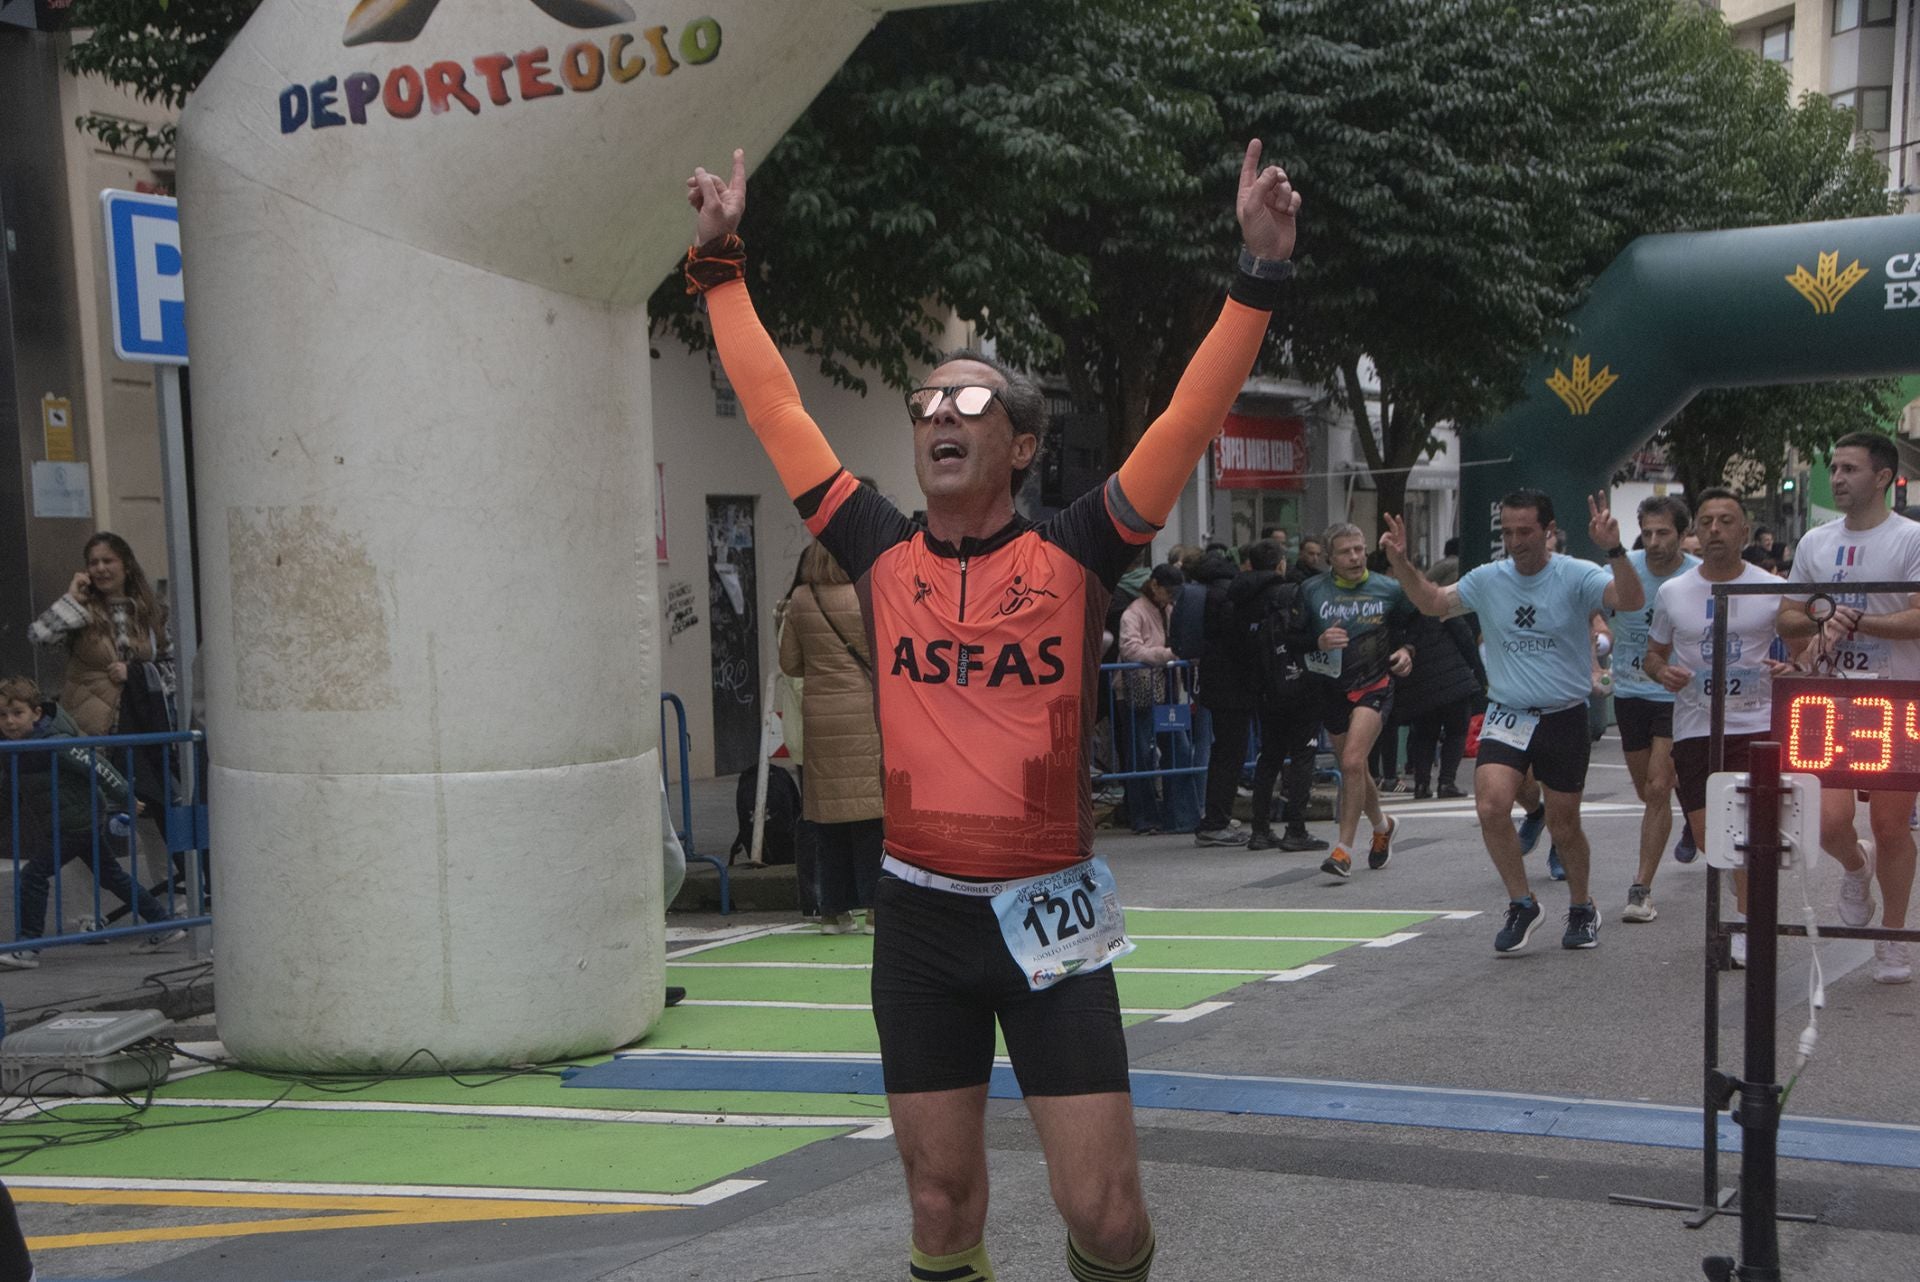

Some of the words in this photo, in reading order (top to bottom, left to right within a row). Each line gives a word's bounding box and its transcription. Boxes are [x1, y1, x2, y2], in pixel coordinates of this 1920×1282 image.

[280, 16, 723, 134] DEPORTEOCIO
[131, 214, 186, 342] P
[891, 636, 1065, 687] ASFAS
[1702, 640, 1742, 655] SF
[957, 648, 968, 685] Badajoz
[1704, 678, 1742, 696] 82
[1487, 711, 1518, 730] 970
[70, 747, 123, 788] HAKETT
[950, 882, 990, 894] ACORRER
[1023, 888, 1096, 948] 120
[1107, 936, 1126, 952] HOY
